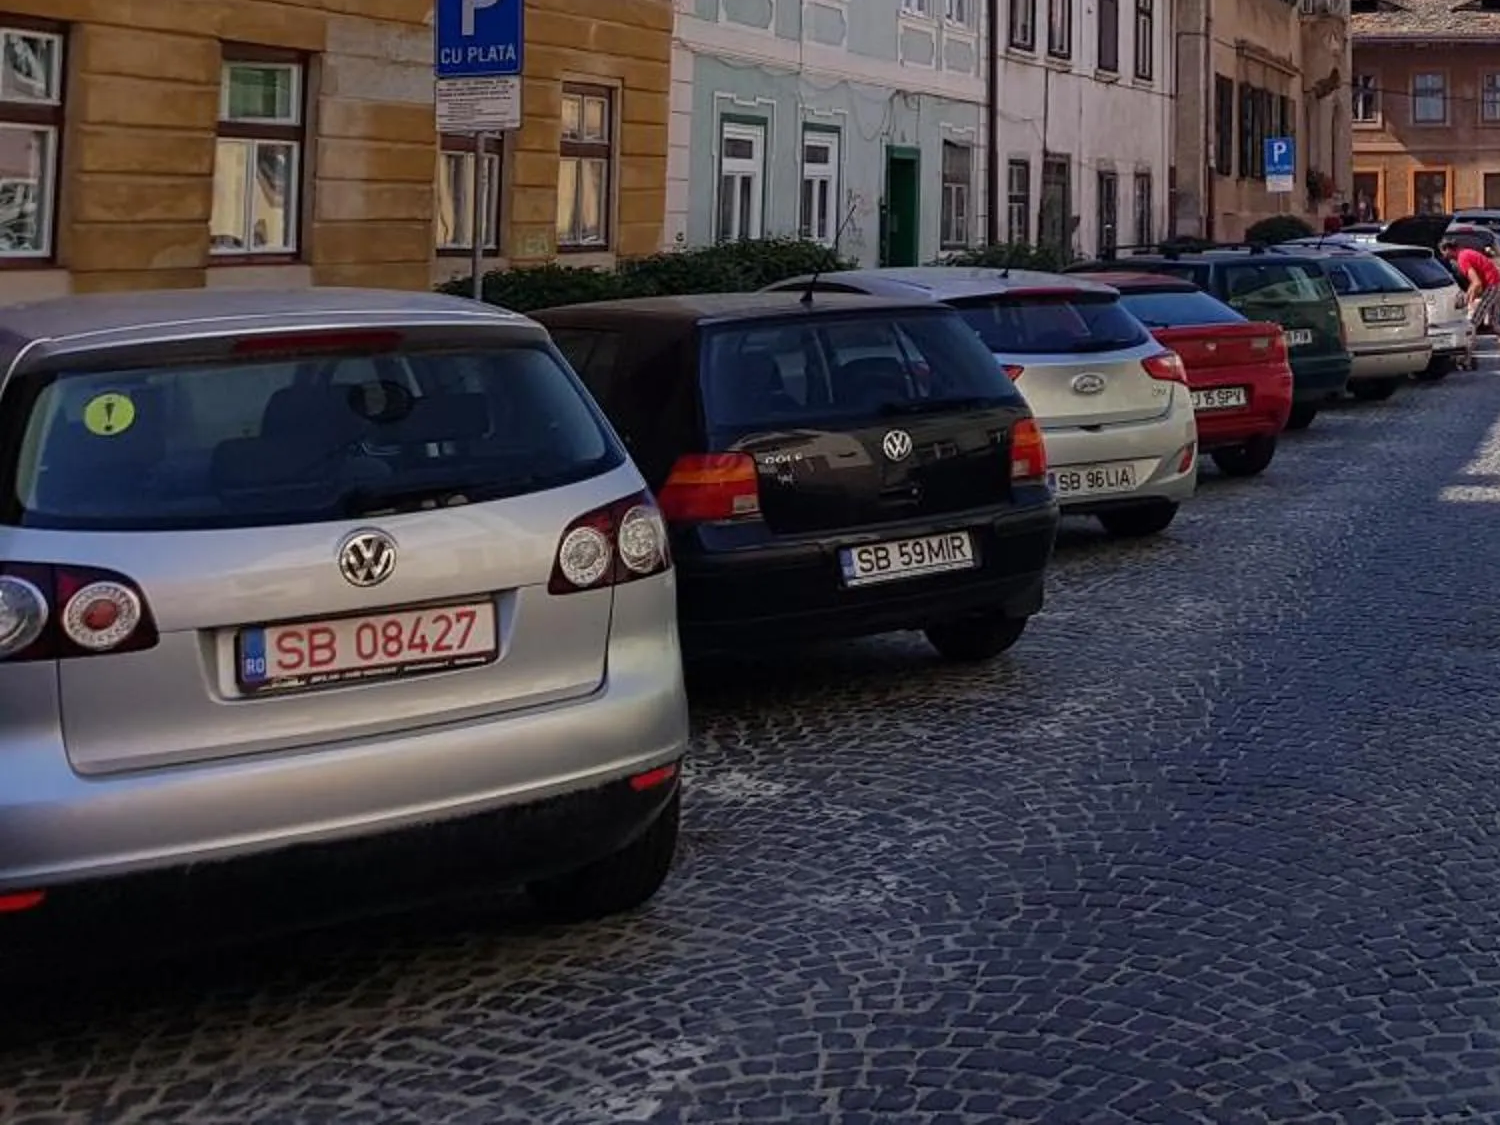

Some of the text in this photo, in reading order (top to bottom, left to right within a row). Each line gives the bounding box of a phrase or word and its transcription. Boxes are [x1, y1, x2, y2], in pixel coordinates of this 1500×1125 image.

[440, 43, 517, 64] CU PLATA
[1273, 142, 1287, 164] P
[1059, 471, 1081, 492] SB
[857, 546, 891, 573] SB
[275, 609, 478, 671] SB 08427
[245, 657, 266, 674] RO
